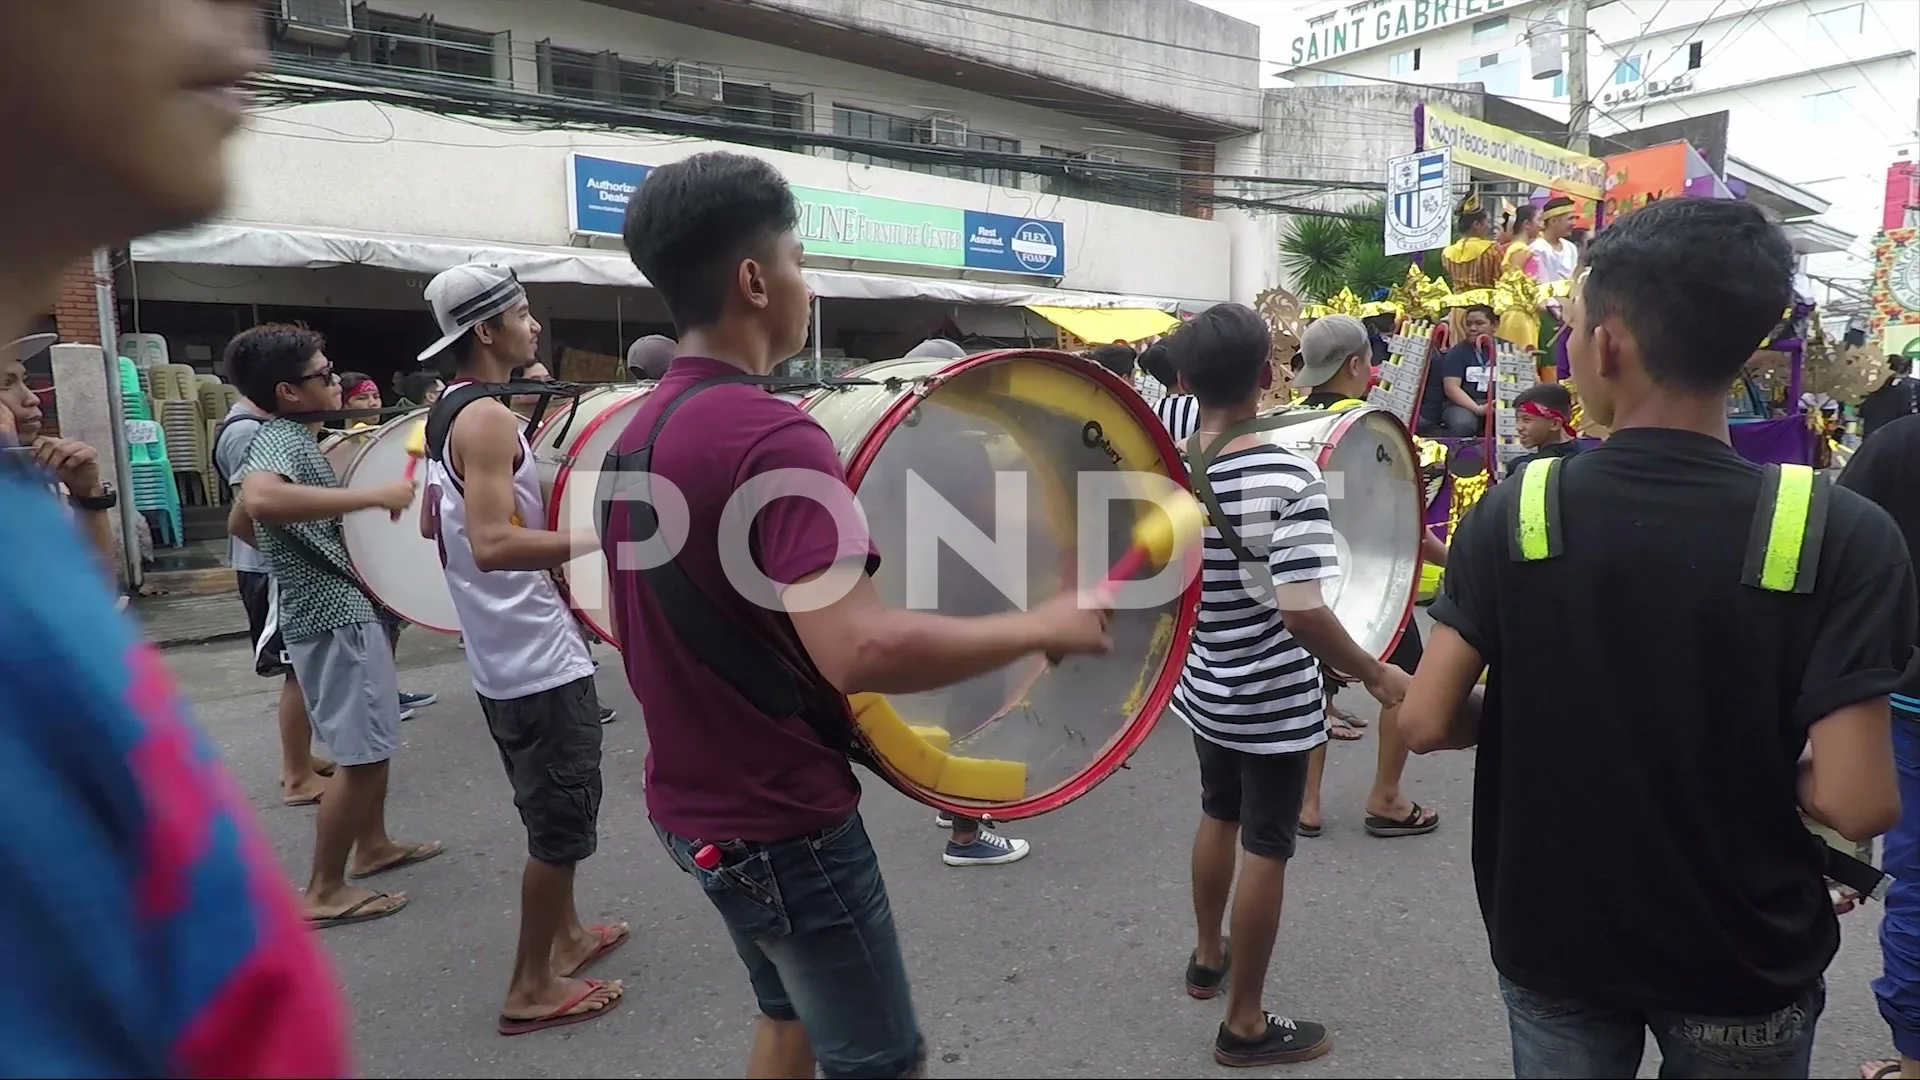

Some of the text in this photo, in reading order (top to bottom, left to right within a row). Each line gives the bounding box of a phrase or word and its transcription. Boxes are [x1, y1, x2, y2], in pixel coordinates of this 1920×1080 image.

[1291, 17, 1364, 66] SAINT
[1428, 116, 1458, 146] Global
[1460, 126, 1489, 156] Peace
[1491, 140, 1508, 161] and
[1508, 142, 1529, 172] Unity
[857, 214, 919, 247] FURNITURE
[921, 222, 962, 250] CENTER
[977, 226, 997, 238] Rest
[1022, 231, 1047, 243] FLEX
[969, 234, 1004, 247] Assured.
[1022, 253, 1047, 264] FOAM
